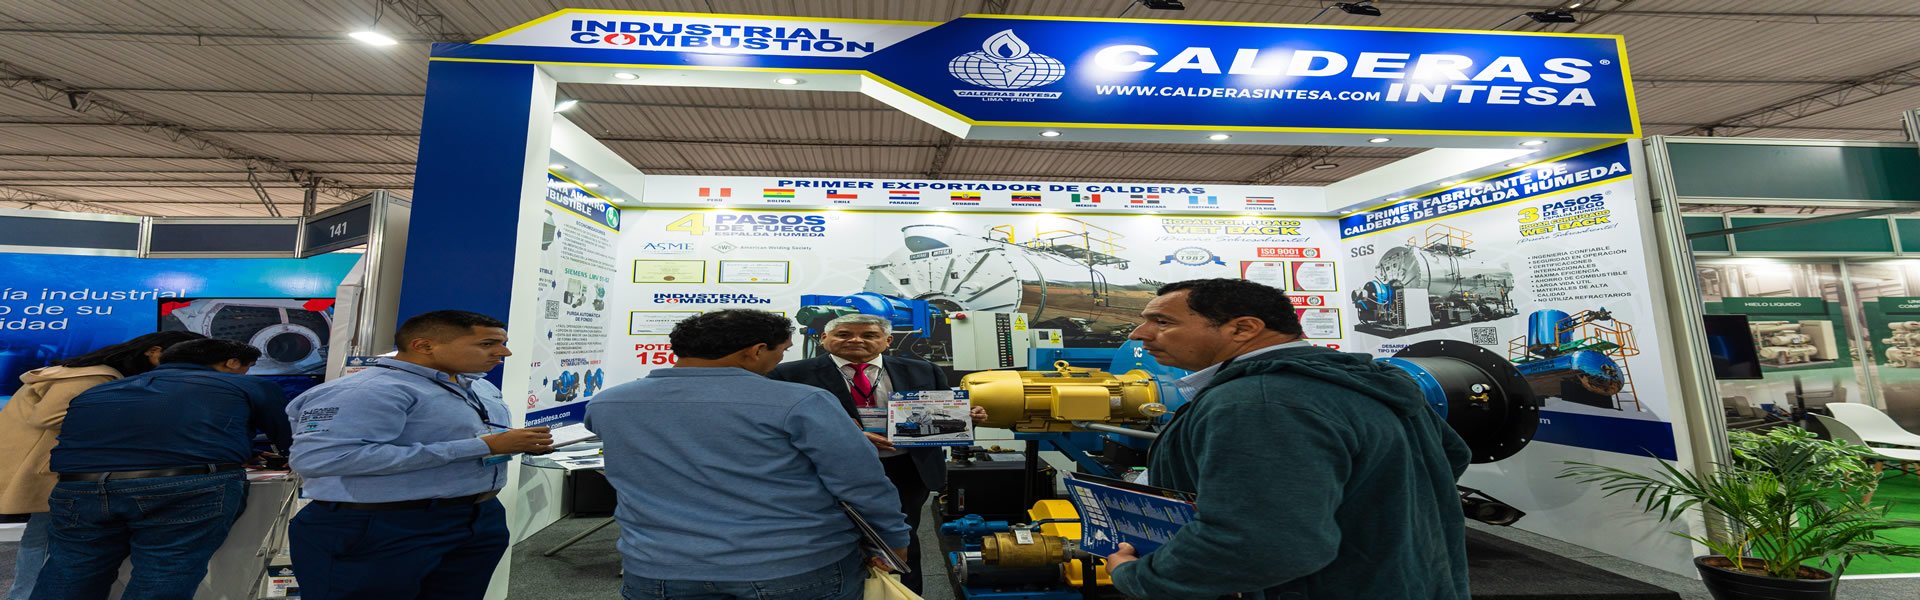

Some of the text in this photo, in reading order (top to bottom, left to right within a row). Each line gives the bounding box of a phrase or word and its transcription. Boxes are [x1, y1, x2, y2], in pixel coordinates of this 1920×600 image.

[571, 20, 843, 42] INDUSTRIAL
[570, 32, 875, 53] COMBUSTION
[1094, 44, 1593, 84] CALDERAS
[1095, 85, 1380, 102] WWW.CALDERASINTESA.COM
[1385, 83, 1597, 107] INTESA
[546, 177, 569, 195] ARA
[778, 179, 874, 189] PRIMER
[882, 182, 1041, 192] EXPORTADOR
[1086, 186, 1206, 195] CALDERAS
[1365, 163, 1569, 223] PRIMER FABRICANTE DE
[546, 189, 593, 216] BUSTIBLE
[1518, 193, 1604, 224] 3 PASOS
[1543, 201, 1605, 218] DE FUEGO
[1343, 213, 1410, 236] CALDERAS
[1412, 208, 1434, 219] DE
[1437, 189, 1520, 214] ESPALDA
[1519, 209, 1611, 231] HOGAR CORRUGADO
[1543, 206, 1605, 221] ESPALDA HUMEDA
[329, 221, 348, 238] 141
[665, 212, 826, 236] 4 PASOS
[715, 225, 826, 234] DE FUEGO
[1163, 225, 1301, 236] WET BACK
[1214, 219, 1301, 227] CORRUGADO
[1519, 215, 1612, 238] WET BACK
[643, 242, 695, 251] ASME
[1350, 244, 1375, 258] SGS
[1569, 246, 1611, 255] CONFIABLE
[1532, 256, 1571, 265] SEGURIDAD
[1533, 259, 1593, 270] CERTIFICACIONES
[564, 268, 588, 278] SIEMENS
[1533, 263, 1596, 274] INTERNACIONALES
[1561, 268, 1600, 276] EFICIENCIA
[1575, 270, 1629, 280] COMBUSTIBLE
[40, 288, 187, 301] industrial
[1536, 285, 1578, 293] MATERIALES
[1574, 292, 1632, 300] REFRACTARIOS
[23, 303, 64, 315] de
[75, 305, 113, 315] su
